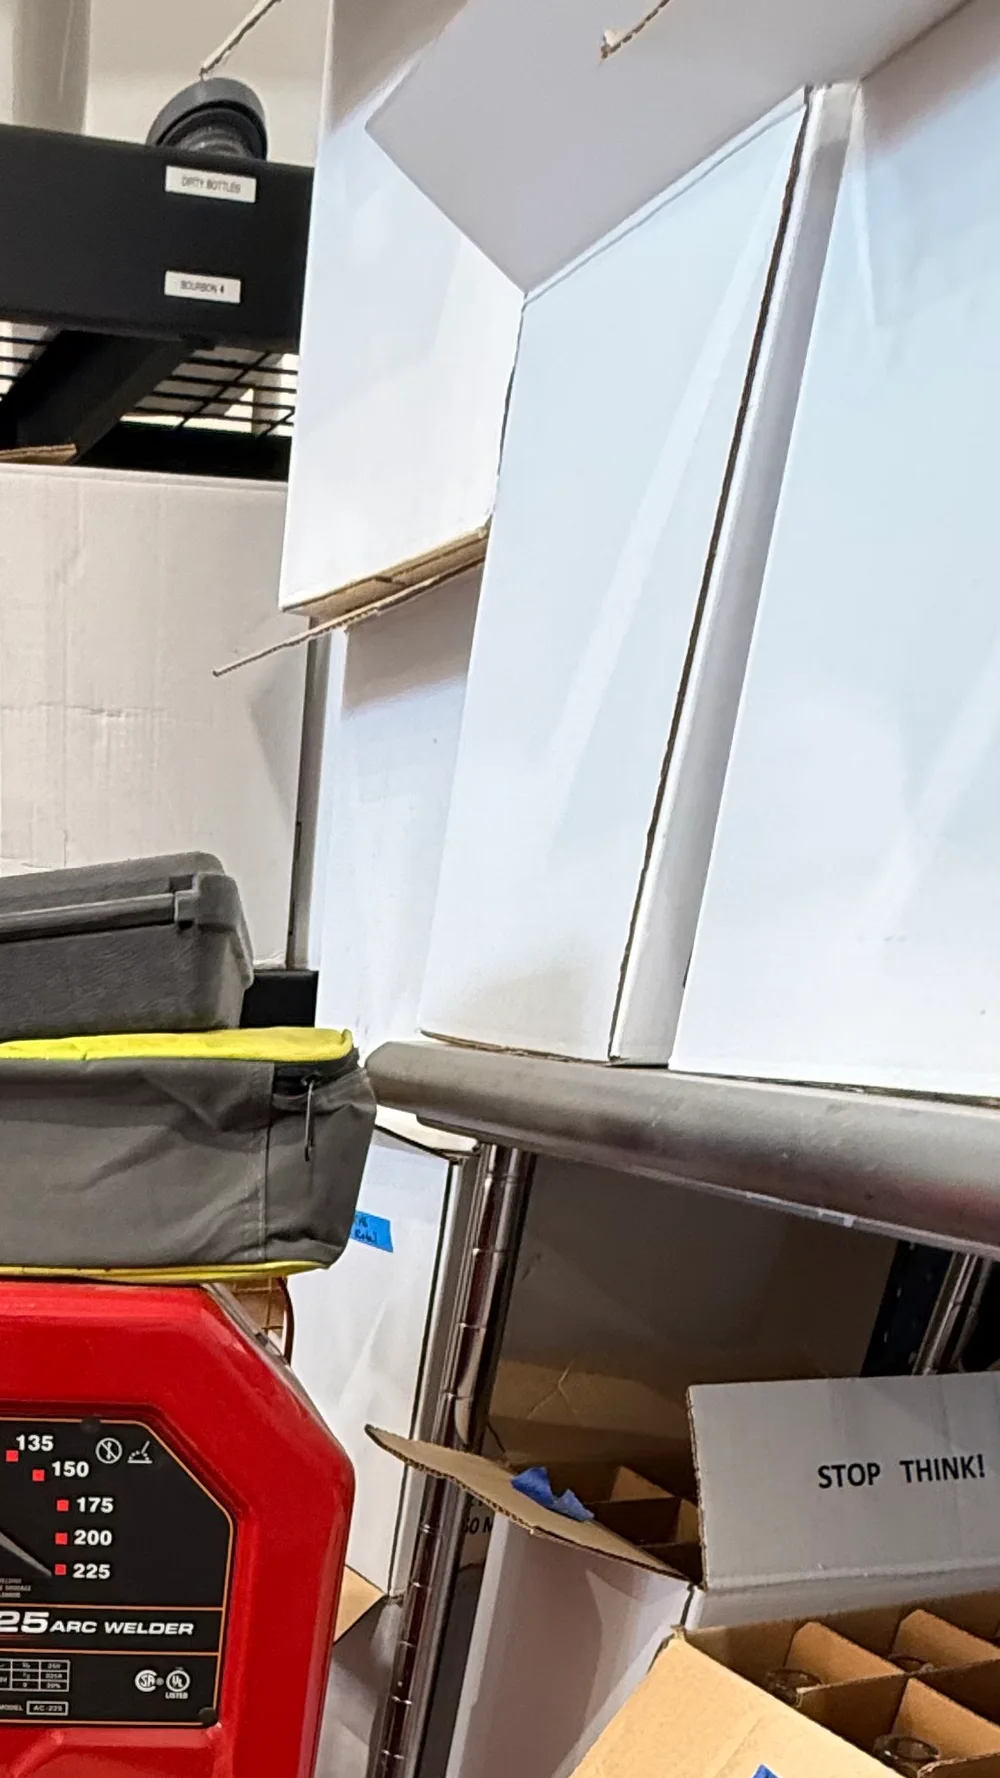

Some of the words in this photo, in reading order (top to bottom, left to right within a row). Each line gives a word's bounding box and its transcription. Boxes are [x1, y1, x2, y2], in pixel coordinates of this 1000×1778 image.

[16, 1433, 54, 1452] 135
[51, 1460, 89, 1478] 150
[817, 1462, 881, 1489] STOP
[899, 1453, 986, 1484] THINK!
[76, 1496, 114, 1514] 175
[74, 1529, 112, 1547] 200
[72, 1563, 111, 1580] 225
[49, 1620, 97, 1634] ARC
[104, 1621, 195, 1636] WELDER
